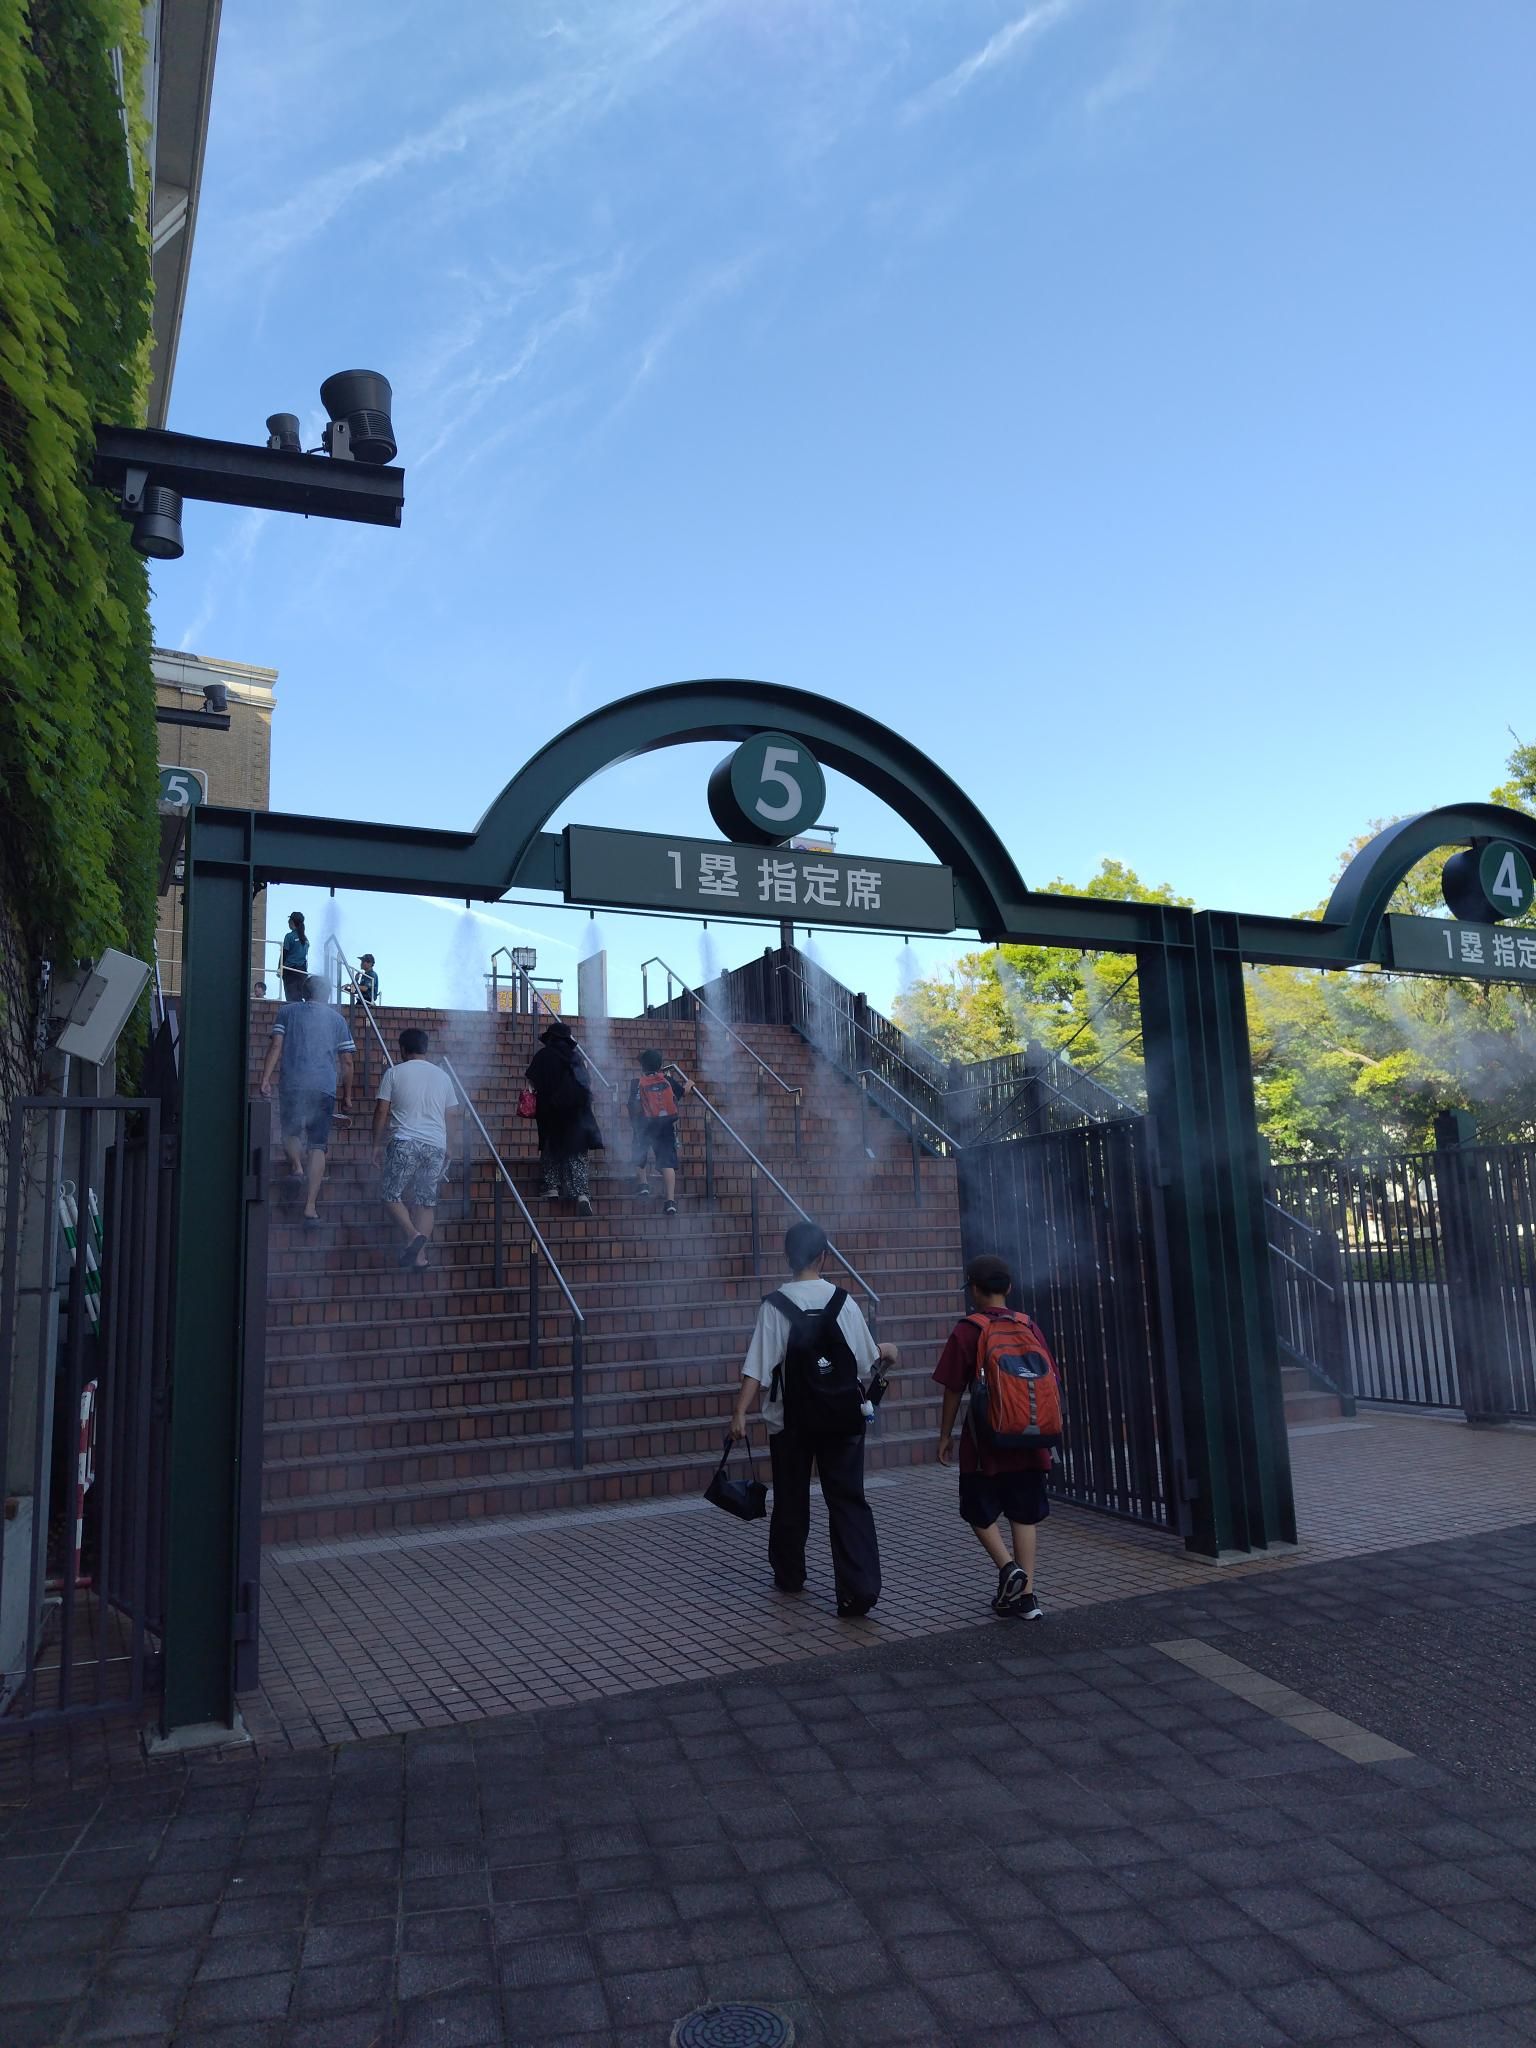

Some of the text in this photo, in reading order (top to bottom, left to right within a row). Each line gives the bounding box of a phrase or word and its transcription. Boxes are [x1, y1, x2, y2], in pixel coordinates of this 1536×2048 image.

[164, 775, 190, 807] 5
[755, 746, 802, 822] 5
[667, 850, 882, 911] 1塁 指定席
[1492, 851, 1523, 907] 4
[1442, 929, 1536, 970] 1塁 指定
